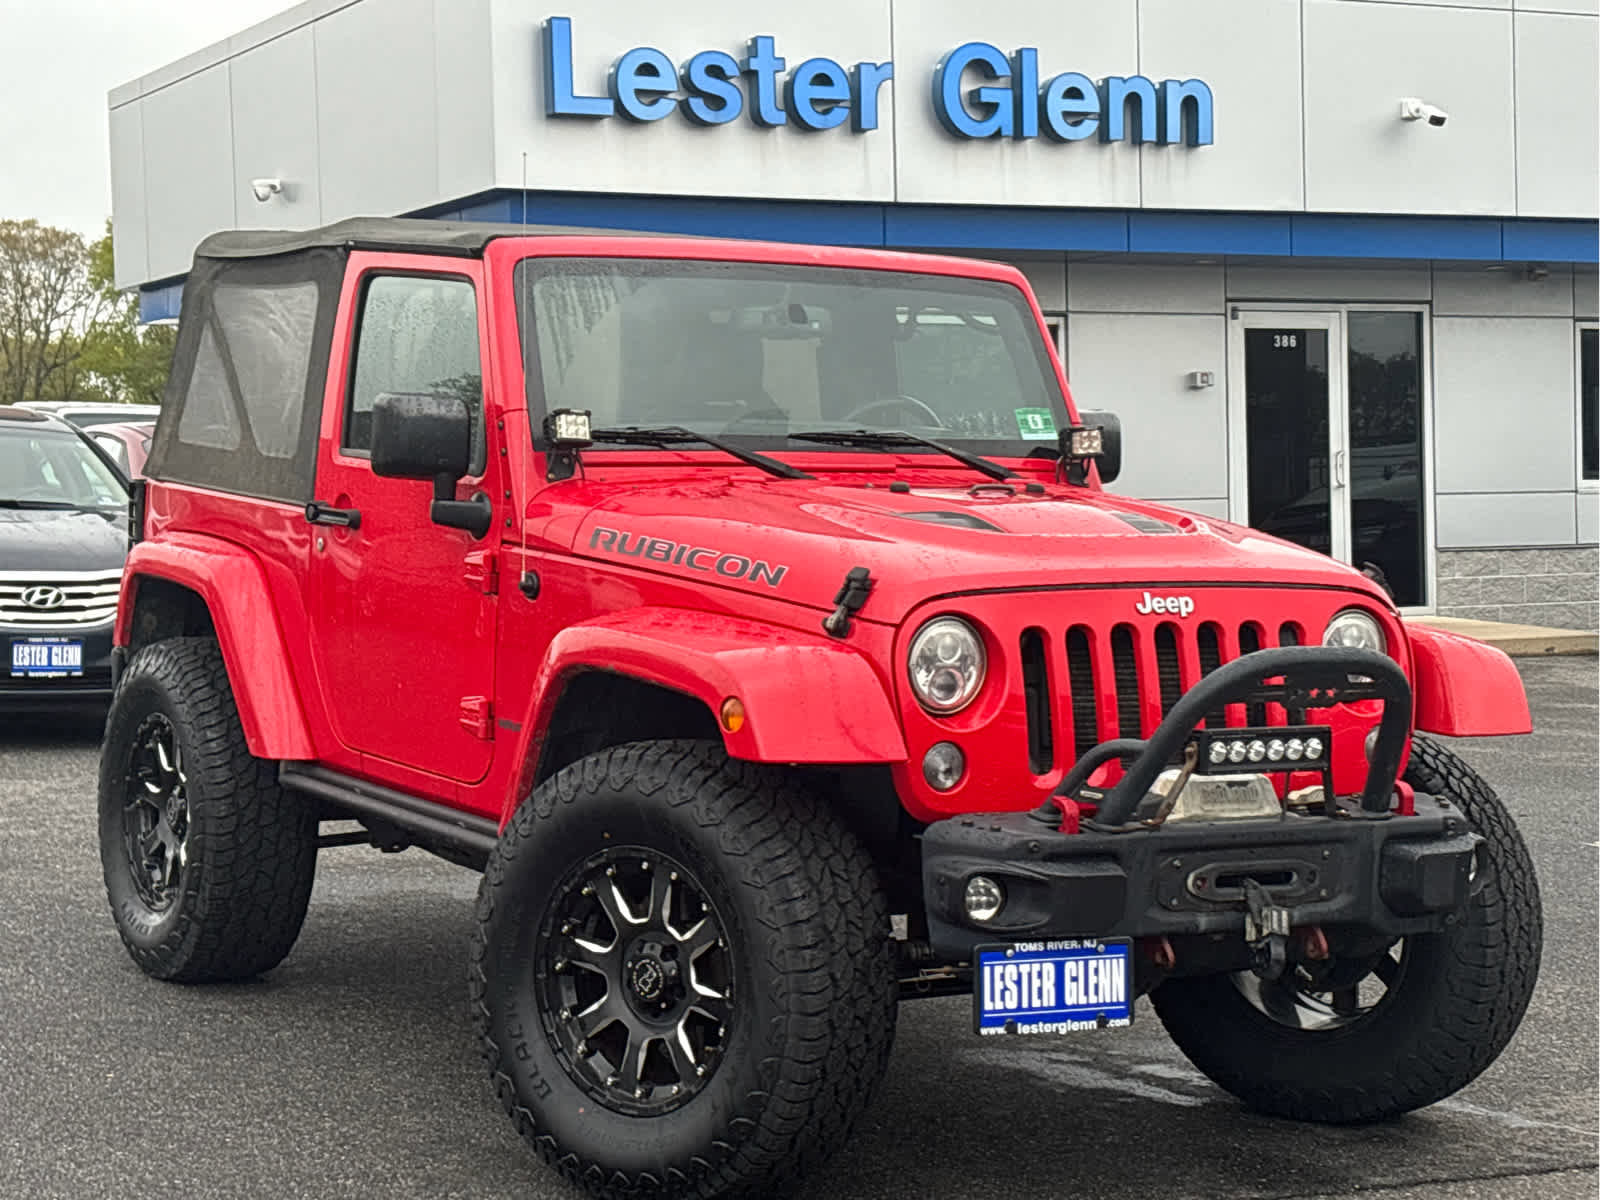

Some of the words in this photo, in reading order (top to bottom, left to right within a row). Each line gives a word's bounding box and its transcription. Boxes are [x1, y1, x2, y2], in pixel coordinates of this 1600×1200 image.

[542, 17, 894, 134] Lester
[932, 41, 1213, 147] Glenn
[1273, 335, 1297, 348] 386
[589, 526, 789, 587] RUBICON
[1135, 591, 1194, 617] Jeep
[13, 645, 48, 666] LESTER
[52, 645, 81, 666] GLENN
[1014, 942, 1045, 952] TOMS
[1083, 939, 1097, 949] NJ
[983, 962, 1056, 1011] LESTER
[1064, 958, 1125, 1006] GLENN
